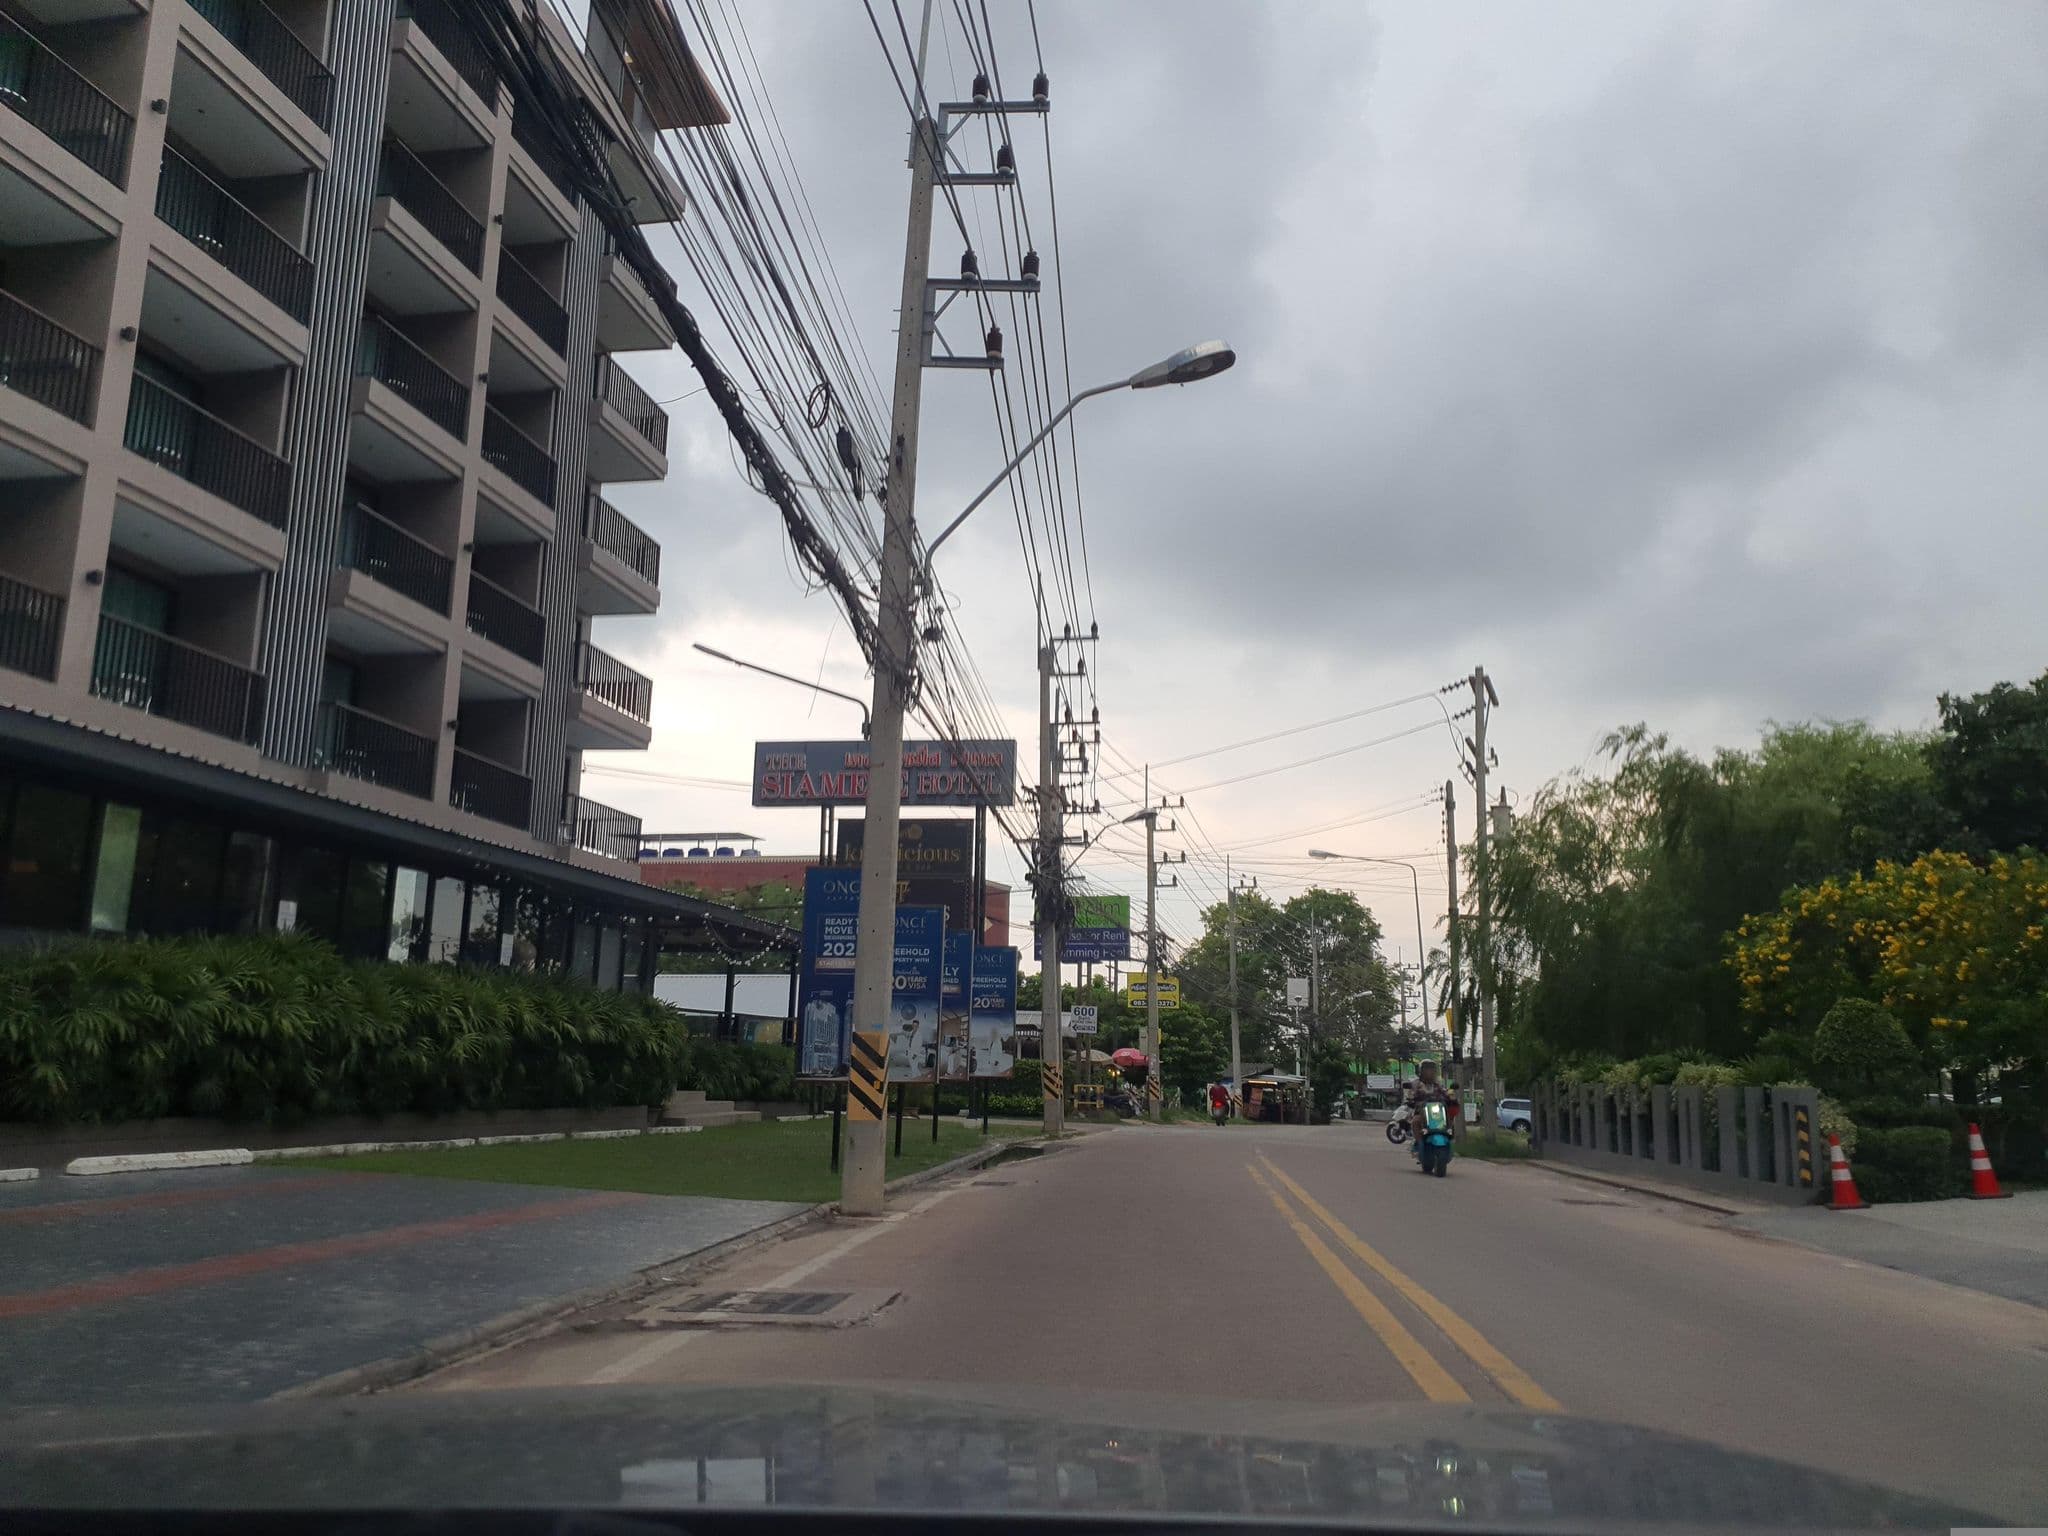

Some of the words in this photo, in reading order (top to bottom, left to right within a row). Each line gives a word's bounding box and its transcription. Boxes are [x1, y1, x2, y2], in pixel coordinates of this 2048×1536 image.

[765, 752, 807, 770] THE
[917, 769, 1001, 796] HOTEL
[825, 918, 853, 926] READY
[824, 926, 854, 935] MOVE
[973, 997, 990, 1009] 20
[1073, 1006, 1095, 1017] 600
